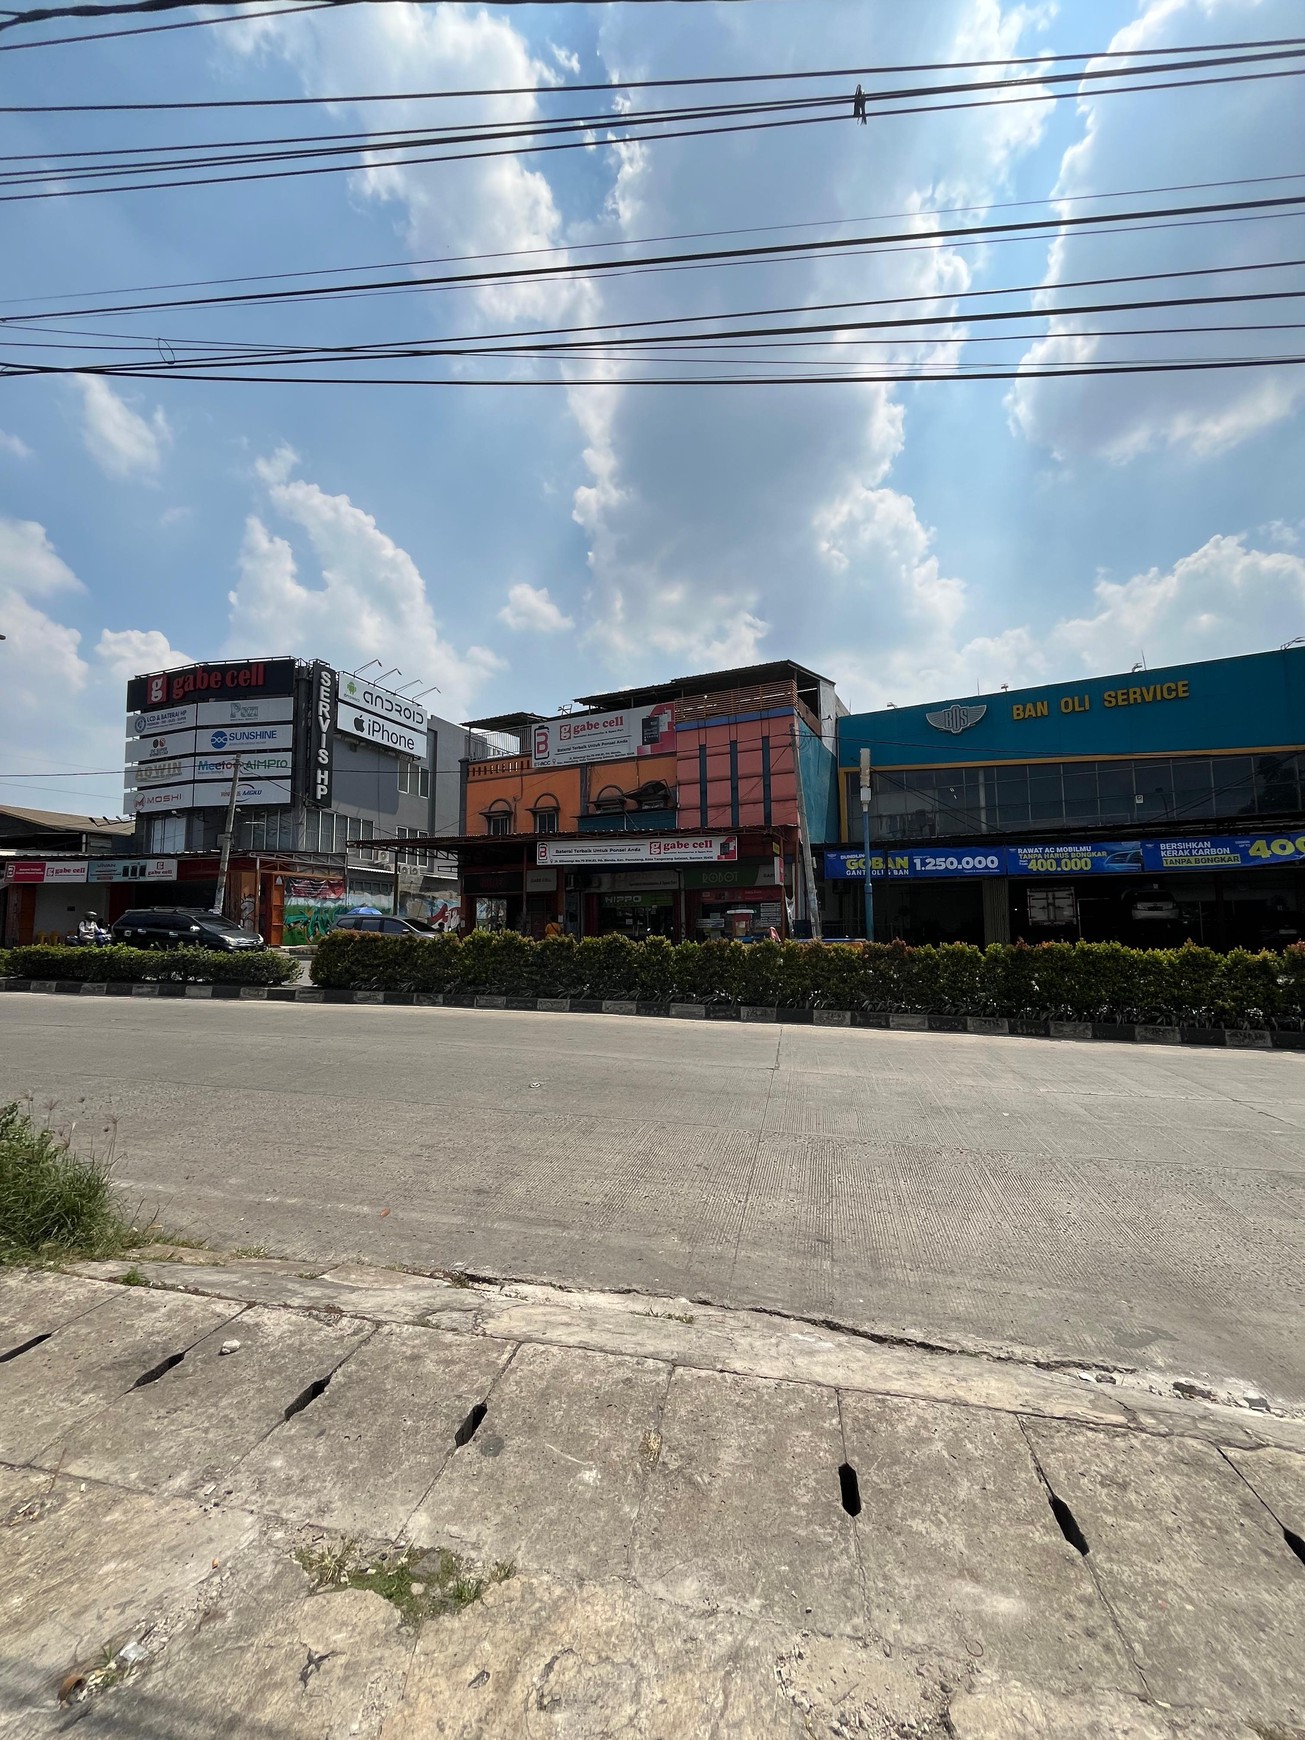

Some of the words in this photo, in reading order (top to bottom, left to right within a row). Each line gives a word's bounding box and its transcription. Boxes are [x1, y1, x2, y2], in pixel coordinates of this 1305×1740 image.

[172, 667, 222, 699] gabe
[225, 663, 265, 687] cell
[1012, 701, 1049, 720] BAN
[1060, 695, 1090, 714] OLI
[1103, 681, 1189, 708] SERVICE
[161, 711, 180, 720] BATERAI
[317, 671, 331, 764] SERVIS
[944, 706, 968, 731] BOS
[573, 720, 600, 735] gabe
[602, 716, 624, 728] cell
[229, 730, 277, 741] SUNSHINE
[367, 719, 415, 750] iPhone
[316, 767, 329, 800] HP
[147, 793, 182, 804] MOSHI
[663, 841, 687, 851] gabe
[692, 840, 713, 849] cell
[1160, 841, 1211, 850] BERSIHKAN
[1160, 849, 1191, 857] KERAK
[1191, 848, 1230, 856] KARBON
[914, 855, 999, 871] 1.250.000
[1028, 858, 1092, 871] 400.000
[1163, 858, 1193, 866] TANPA
[1194, 856, 1240, 865] BONGKAR
[702, 871, 739, 884] ROBOT
[604, 895, 642, 904] HIPPO
